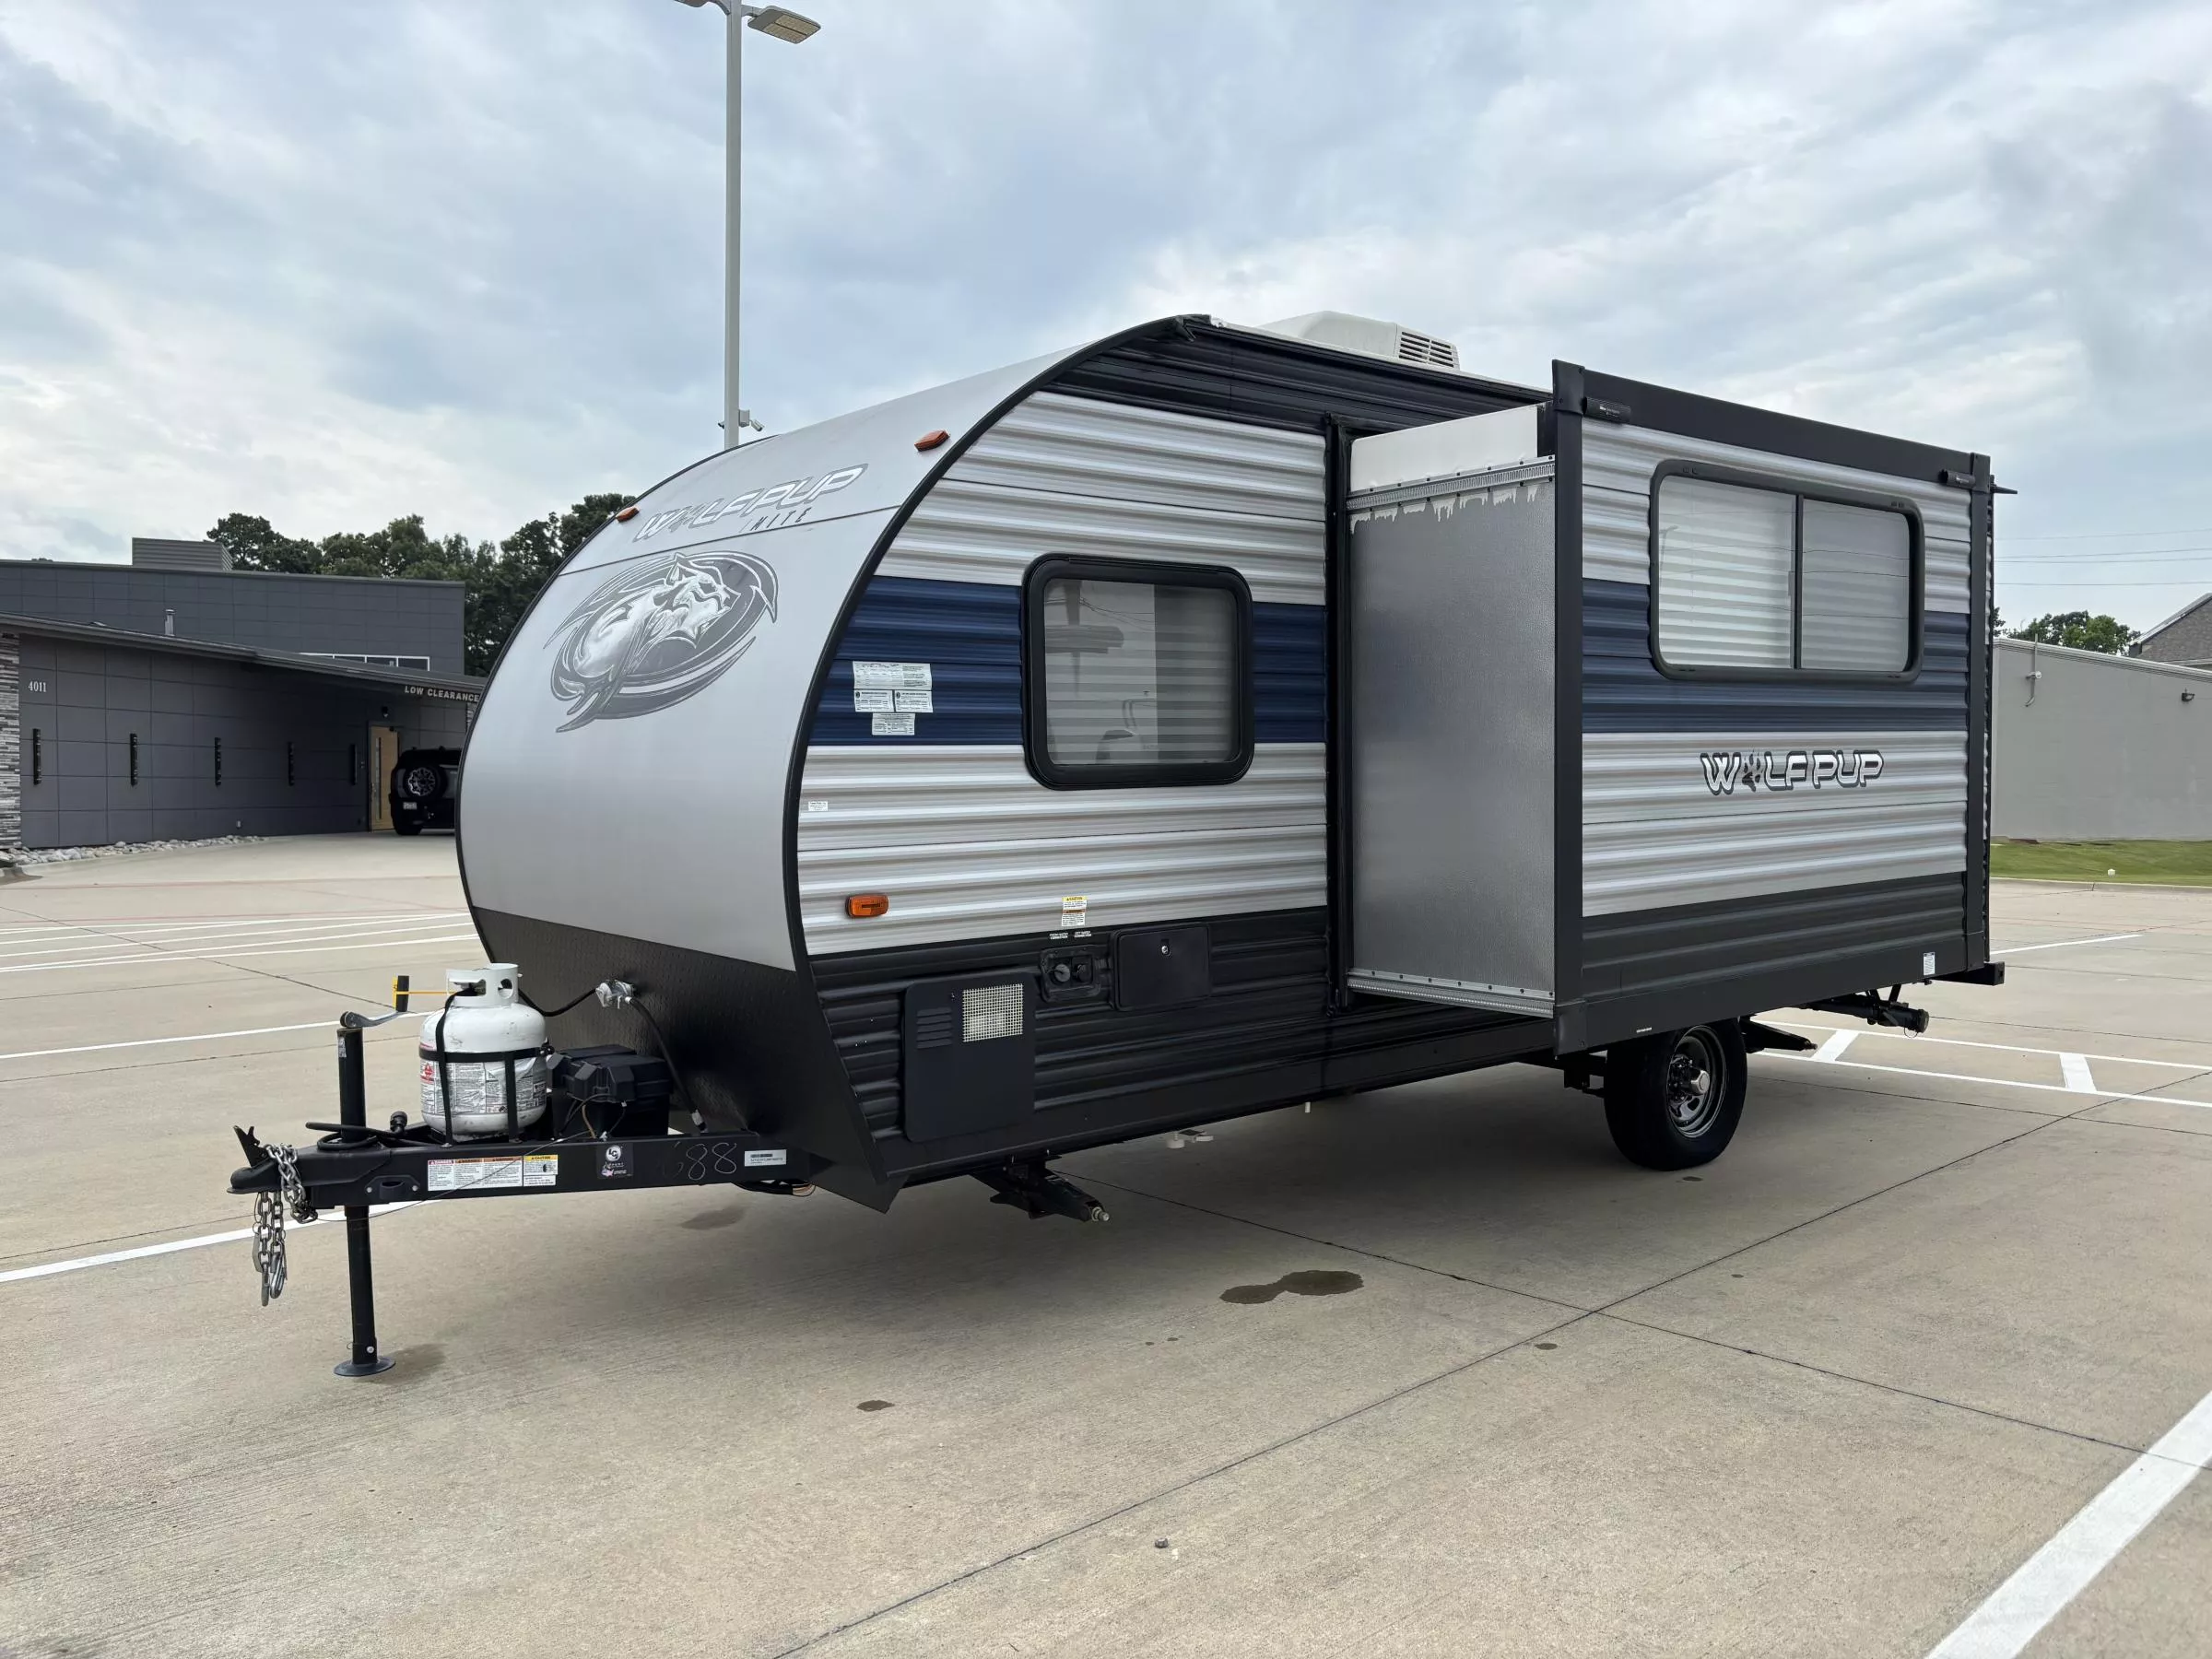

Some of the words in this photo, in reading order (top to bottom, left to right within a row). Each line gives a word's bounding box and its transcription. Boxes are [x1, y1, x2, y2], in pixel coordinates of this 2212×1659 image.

[28, 680, 47, 693] 4011
[405, 686, 424, 695] LOW
[428, 688, 480, 702] CLEARANCE
